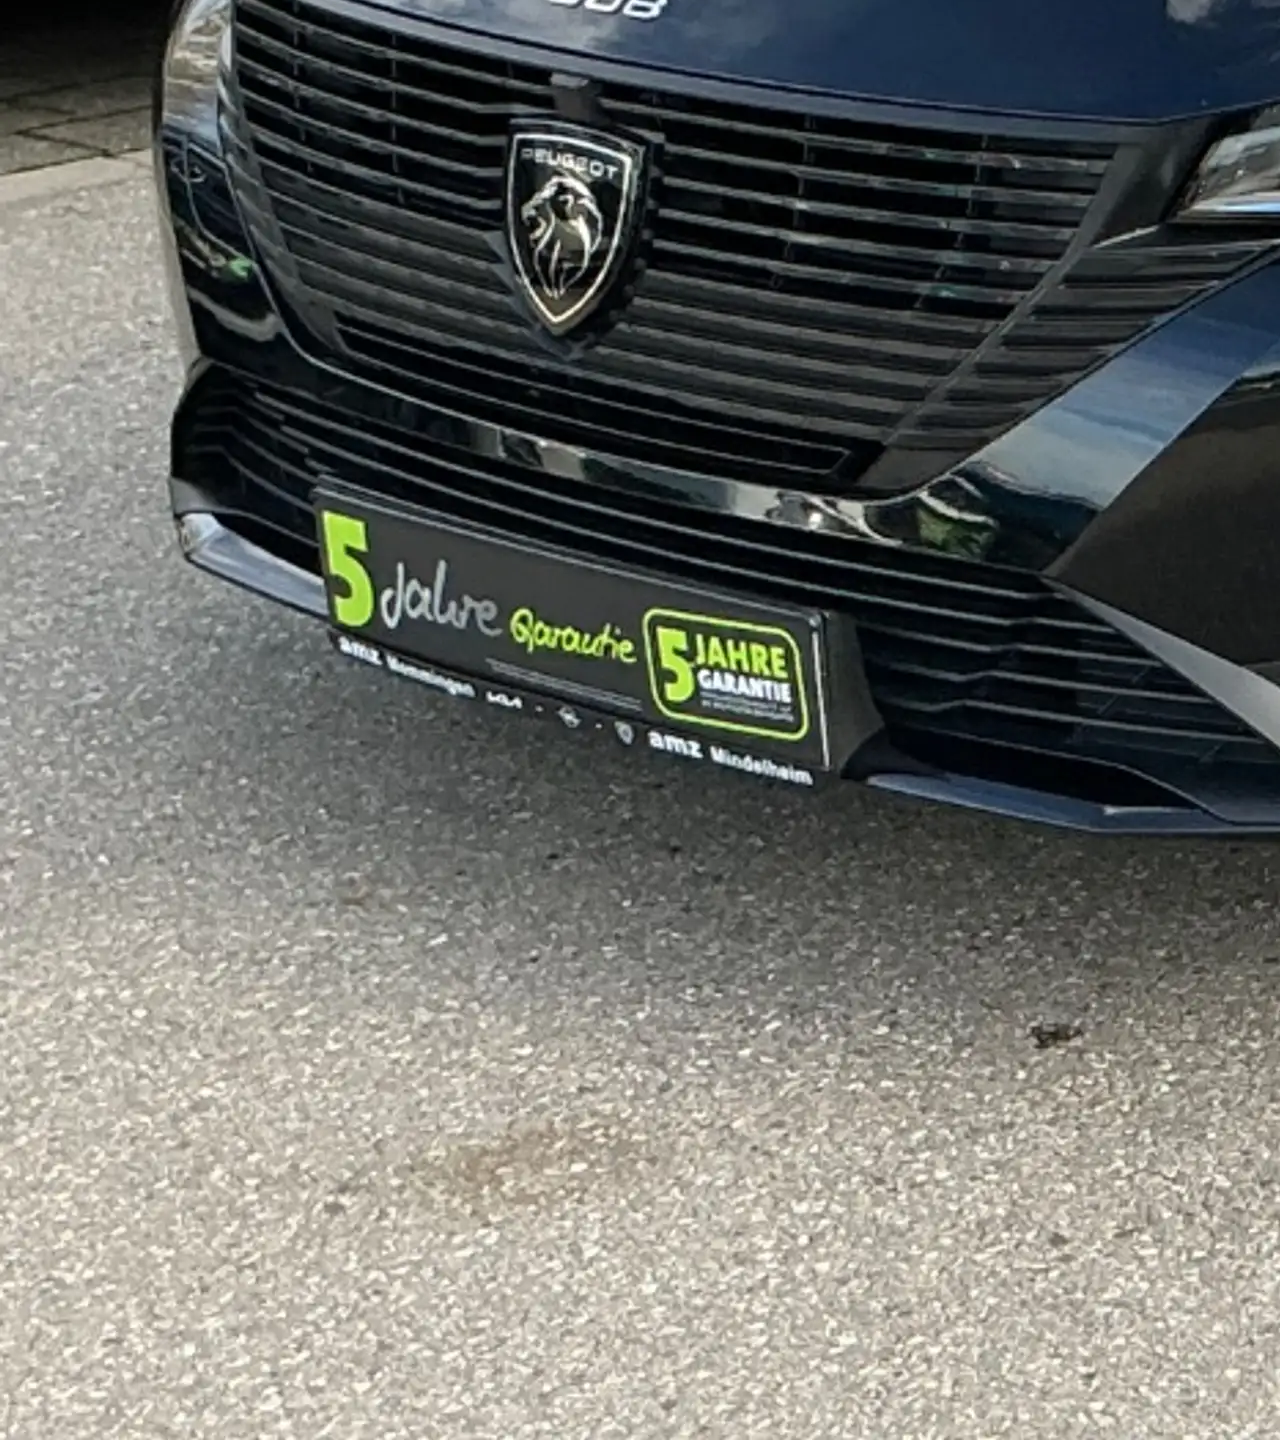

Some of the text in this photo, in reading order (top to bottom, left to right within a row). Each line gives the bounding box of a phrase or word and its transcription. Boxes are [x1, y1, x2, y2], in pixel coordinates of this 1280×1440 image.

[521, 147, 619, 178] PEUGEOT
[322, 511, 375, 627] 5
[656, 626, 695, 701] 5
[695, 633, 789, 679] JAHRE
[697, 669, 792, 704] GARANTIE
[338, 635, 383, 667] amz
[647, 729, 704, 759] amz
[709, 745, 814, 786] Mindelheim
